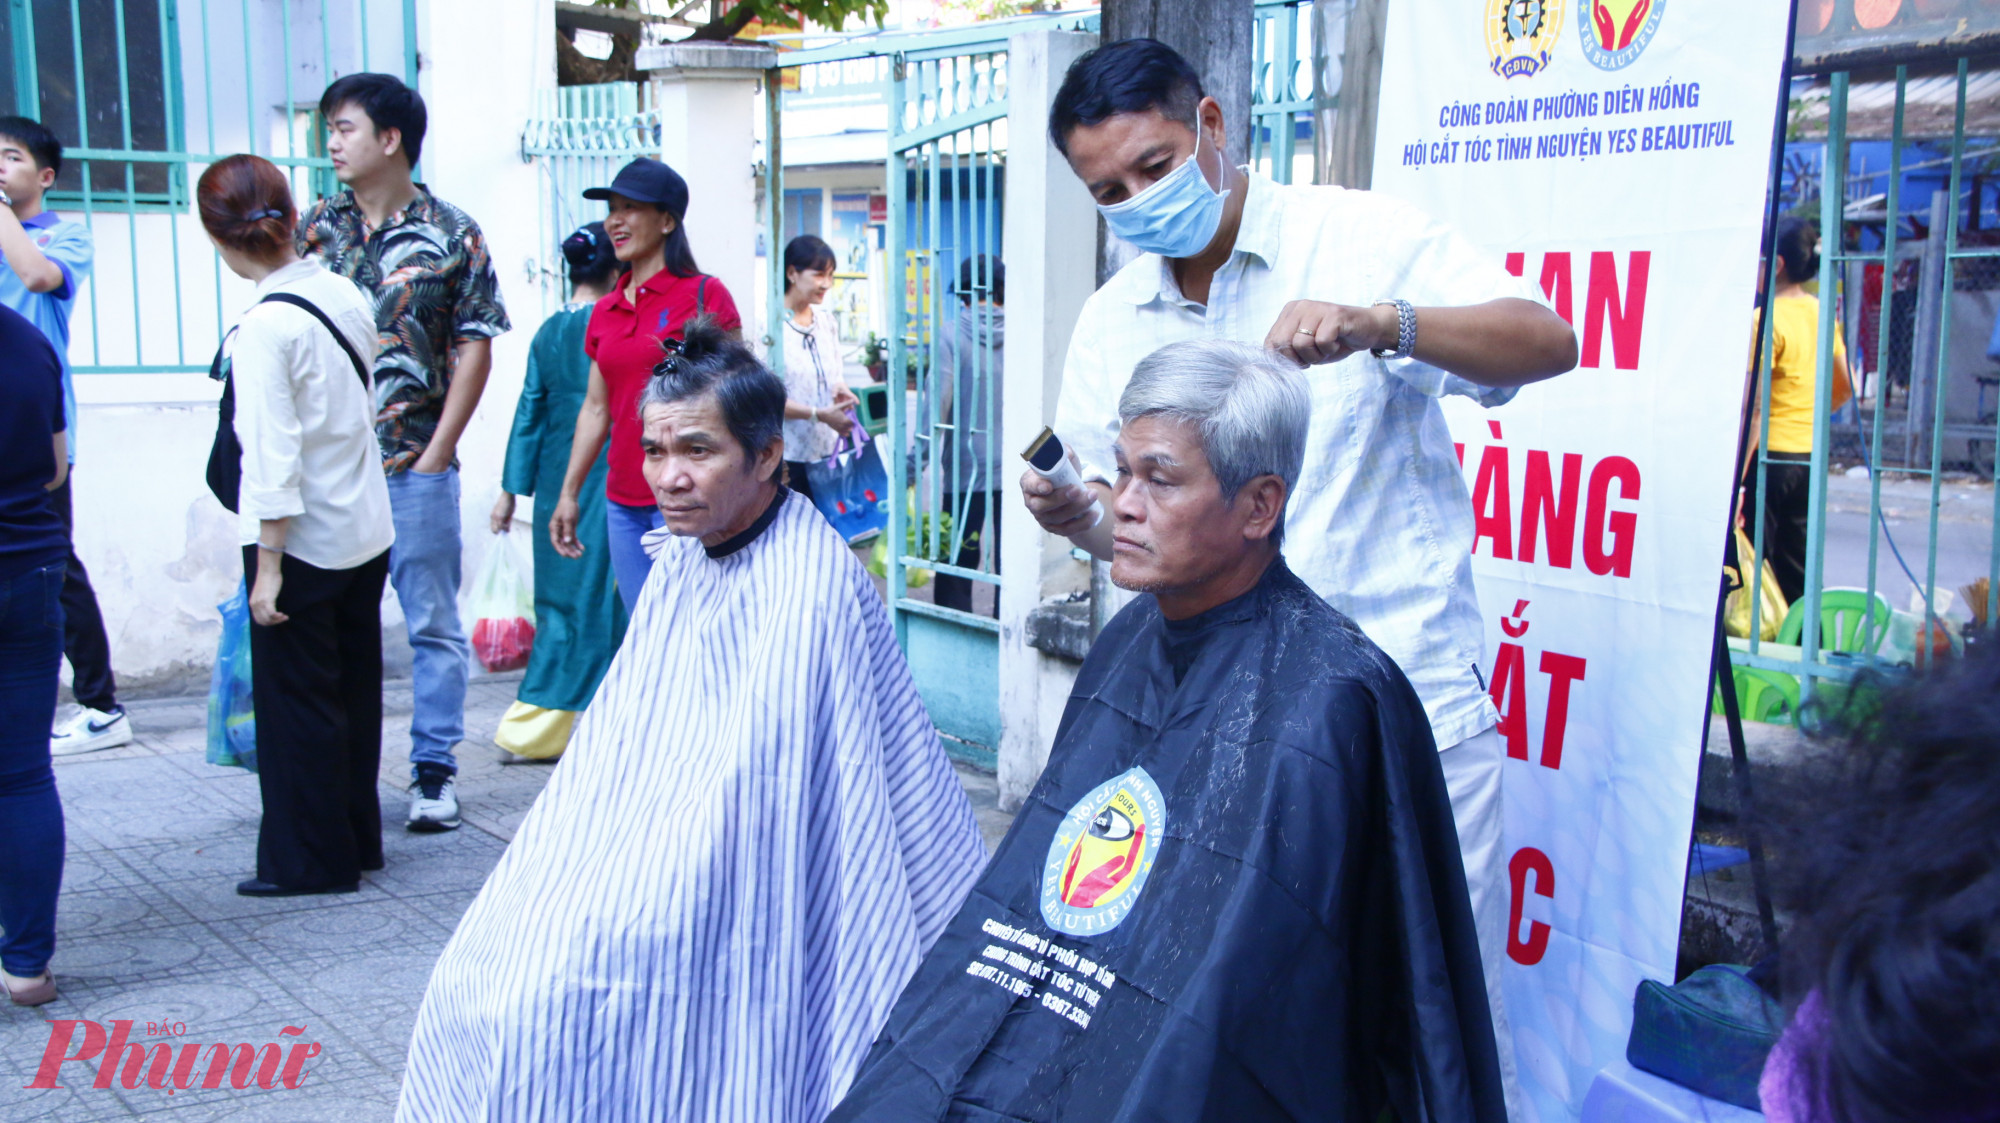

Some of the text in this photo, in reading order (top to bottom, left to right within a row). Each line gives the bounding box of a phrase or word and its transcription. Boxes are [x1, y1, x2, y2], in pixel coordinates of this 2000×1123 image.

[1504, 58, 1536, 76] CĐVN
[1580, 10, 1661, 69] YES BEAUTIFUL
[1438, 99, 1482, 129] CÔNG
[1485, 95, 1529, 125] ĐOÀN
[1532, 88, 1599, 121] PHƯỜNG
[1603, 83, 1645, 116] DIÊN
[1402, 119, 1735, 171] HỘI CẮT TÓC TÌNH NGUYỆN YES BEAUTIFUL
[1505, 250, 1651, 371] AN
[1455, 419, 1641, 579] ÀNG
[1045, 859, 1143, 931] YES BEAUTIFUL
[1050, 970, 1075, 993] TÓC
